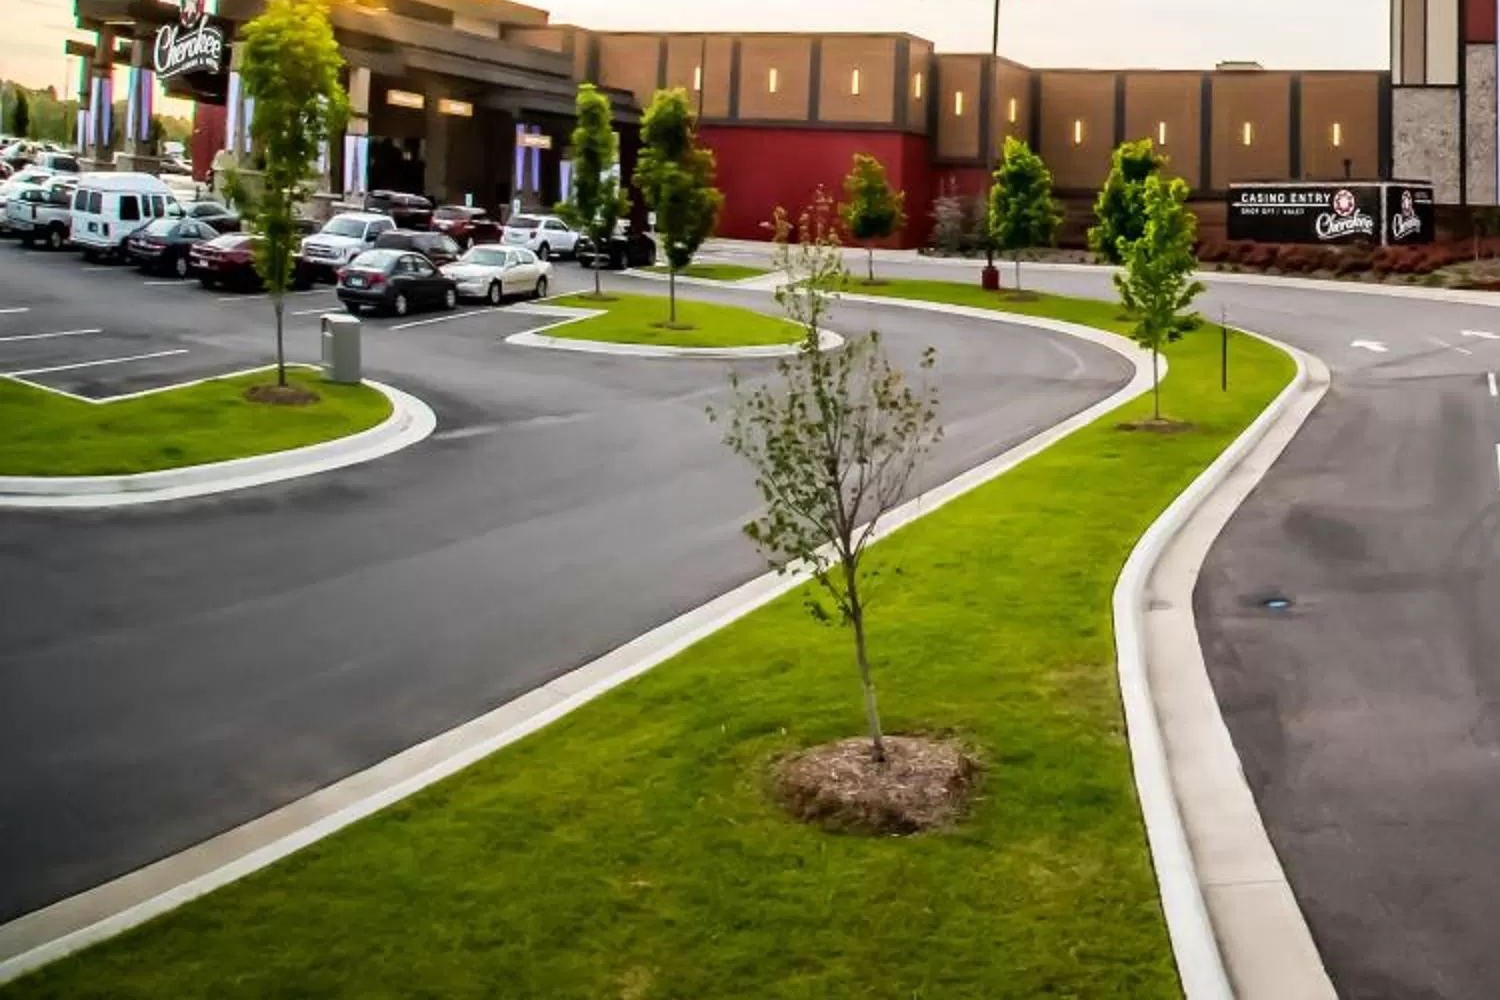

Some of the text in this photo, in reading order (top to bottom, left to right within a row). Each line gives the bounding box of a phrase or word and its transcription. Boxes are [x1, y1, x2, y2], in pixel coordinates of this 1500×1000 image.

[154, 14, 221, 72] Cherokee
[1241, 193, 1331, 203] CASINO ENTRY
